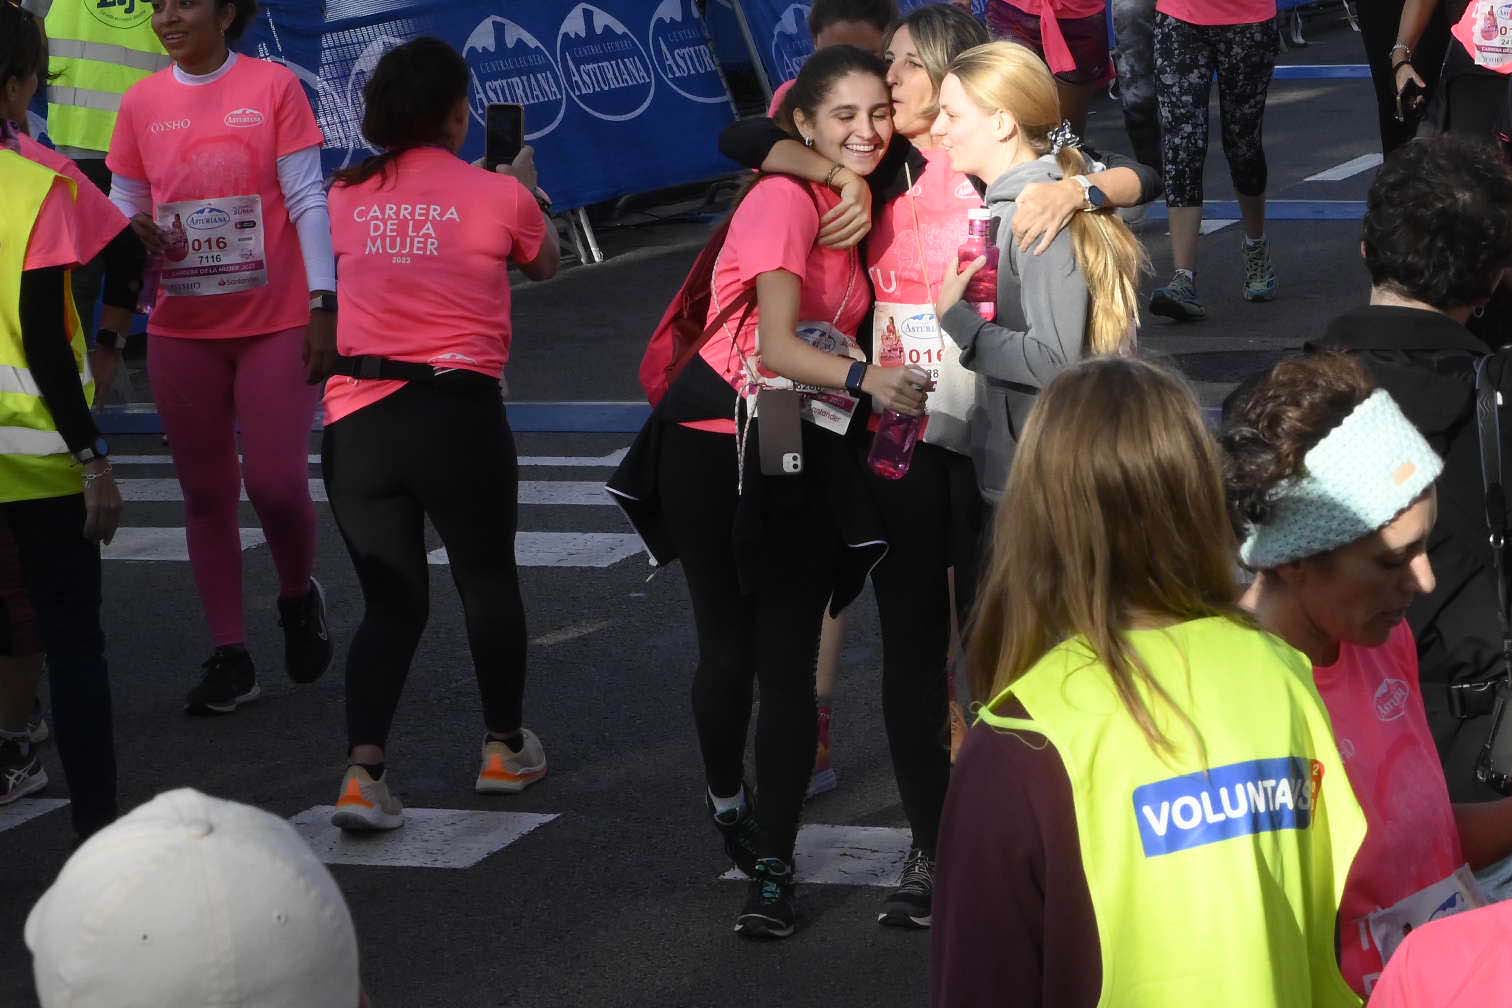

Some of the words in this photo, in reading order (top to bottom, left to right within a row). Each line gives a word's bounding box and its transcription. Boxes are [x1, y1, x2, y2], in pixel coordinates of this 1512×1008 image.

[570, 50, 651, 96] ASTURIANA
[151, 118, 191, 134] OYSHO
[353, 204, 461, 222] CARRERA
[370, 220, 398, 236] DE
[408, 221, 436, 237] LA
[191, 236, 227, 252] 016
[365, 237, 438, 255] MUJER
[199, 254, 222, 265] 7116
